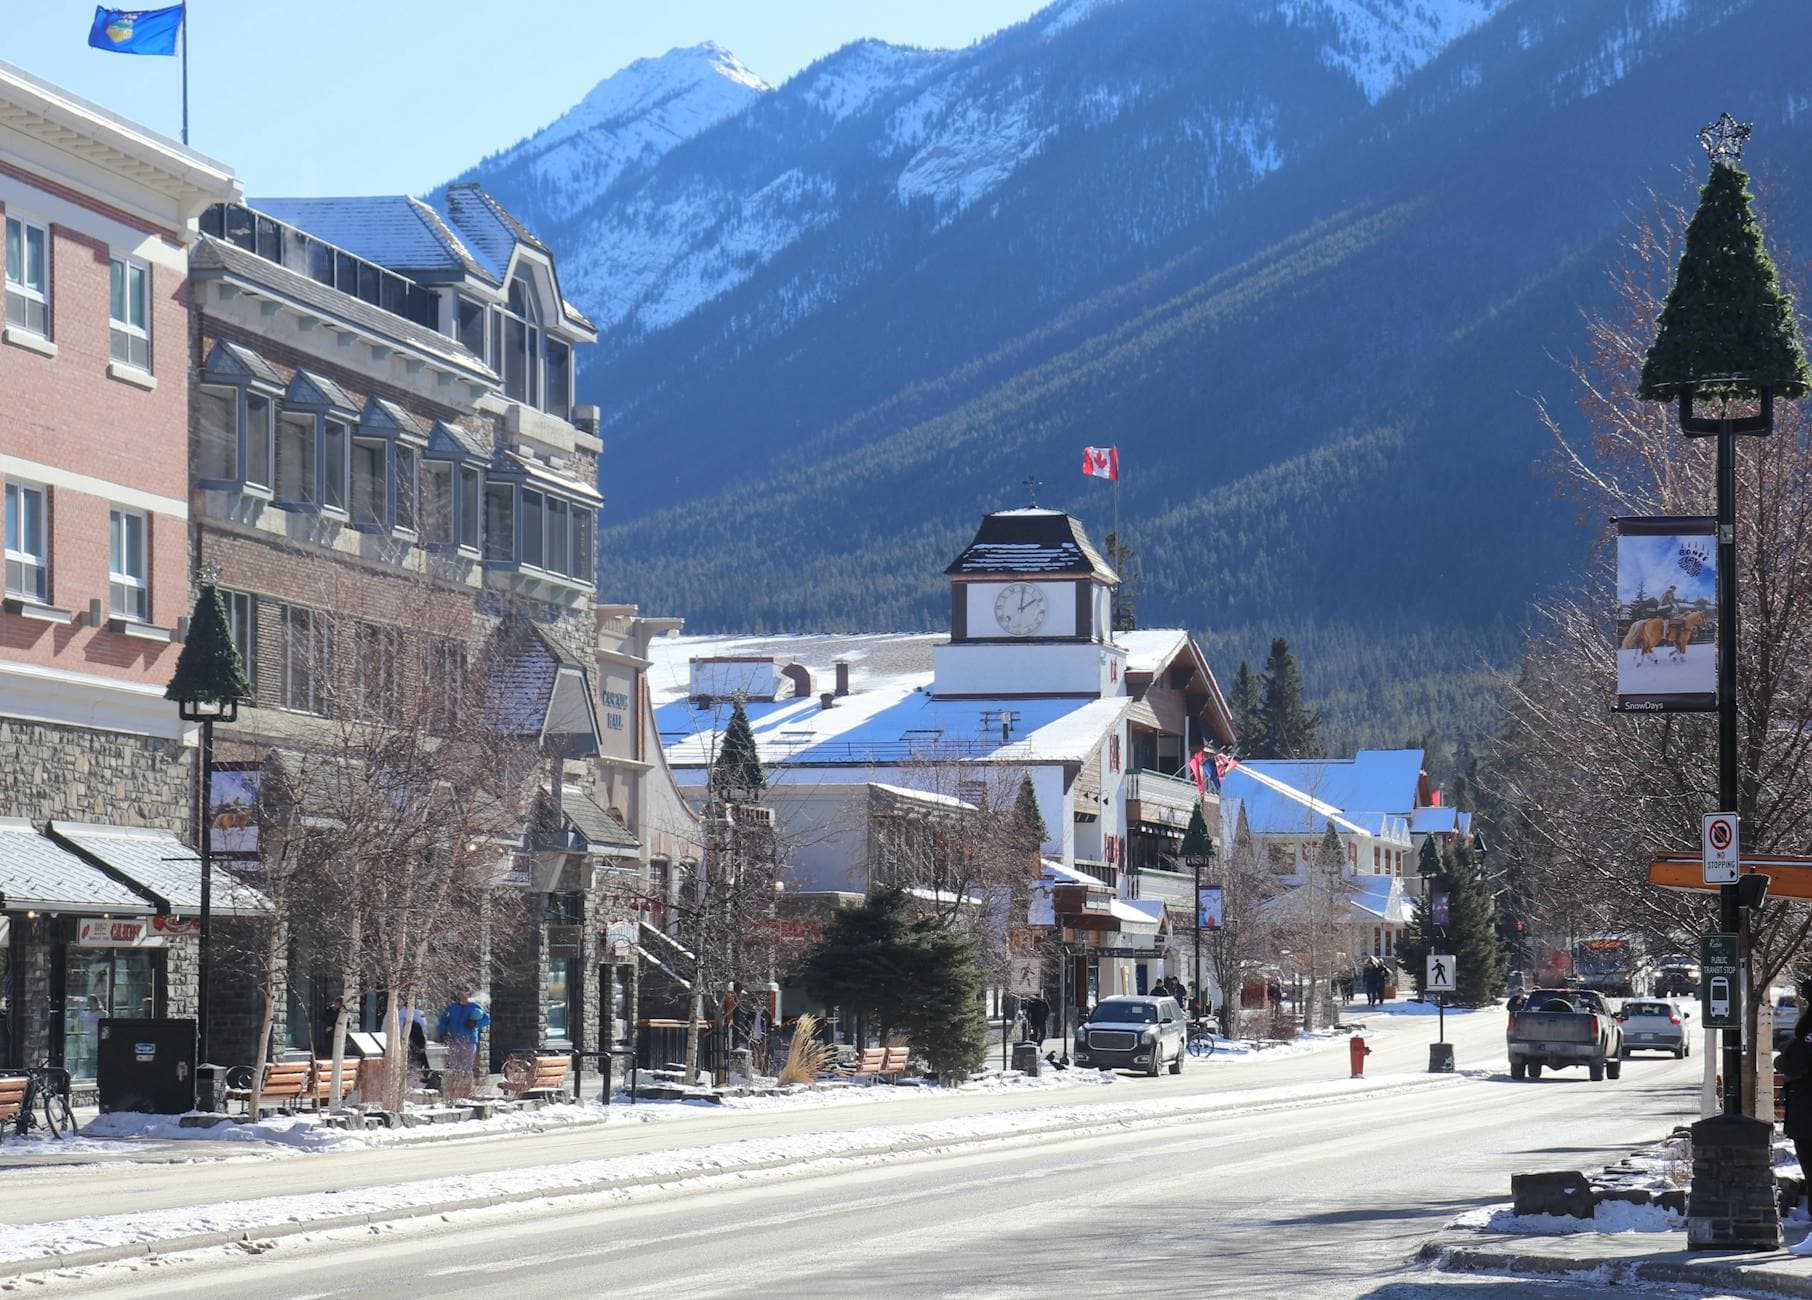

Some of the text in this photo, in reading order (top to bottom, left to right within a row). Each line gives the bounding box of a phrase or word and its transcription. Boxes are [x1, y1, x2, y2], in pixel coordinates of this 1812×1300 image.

[1625, 701, 1664, 711] SnowDays
[1716, 851, 1726, 860] NO
[1707, 861, 1736, 870] STOPPING
[1711, 956, 1728, 965] PUBLIC
[1703, 965, 1736, 975] TRANSIT STOP
